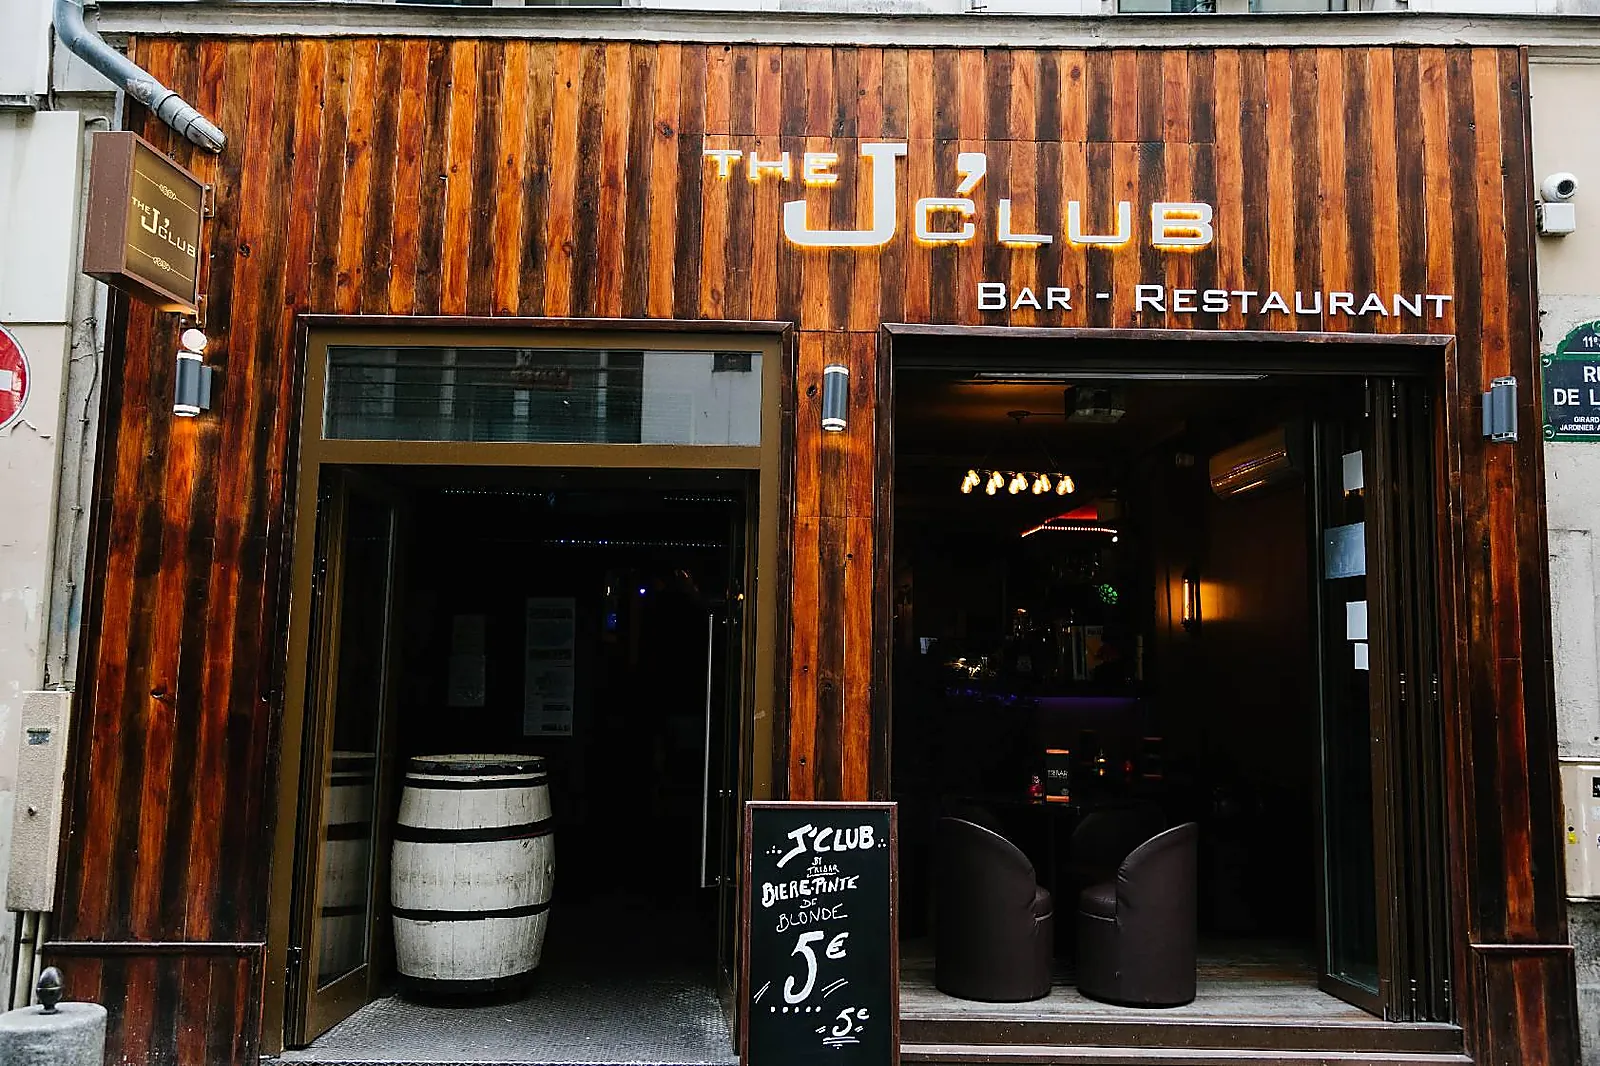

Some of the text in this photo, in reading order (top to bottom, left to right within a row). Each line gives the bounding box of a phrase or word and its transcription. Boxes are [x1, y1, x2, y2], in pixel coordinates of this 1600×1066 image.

[703, 148, 838, 182] THE
[131, 196, 151, 215] THE
[783, 142, 1213, 247] J'CLUB
[977, 282, 1071, 311] BAR
[1135, 284, 1453, 318] RESTAURANT
[1553, 388, 1580, 406] DE
[777, 823, 875, 868] J'CLUB
[776, 903, 848, 932] BLONDE
[800, 898, 818, 909] DE
